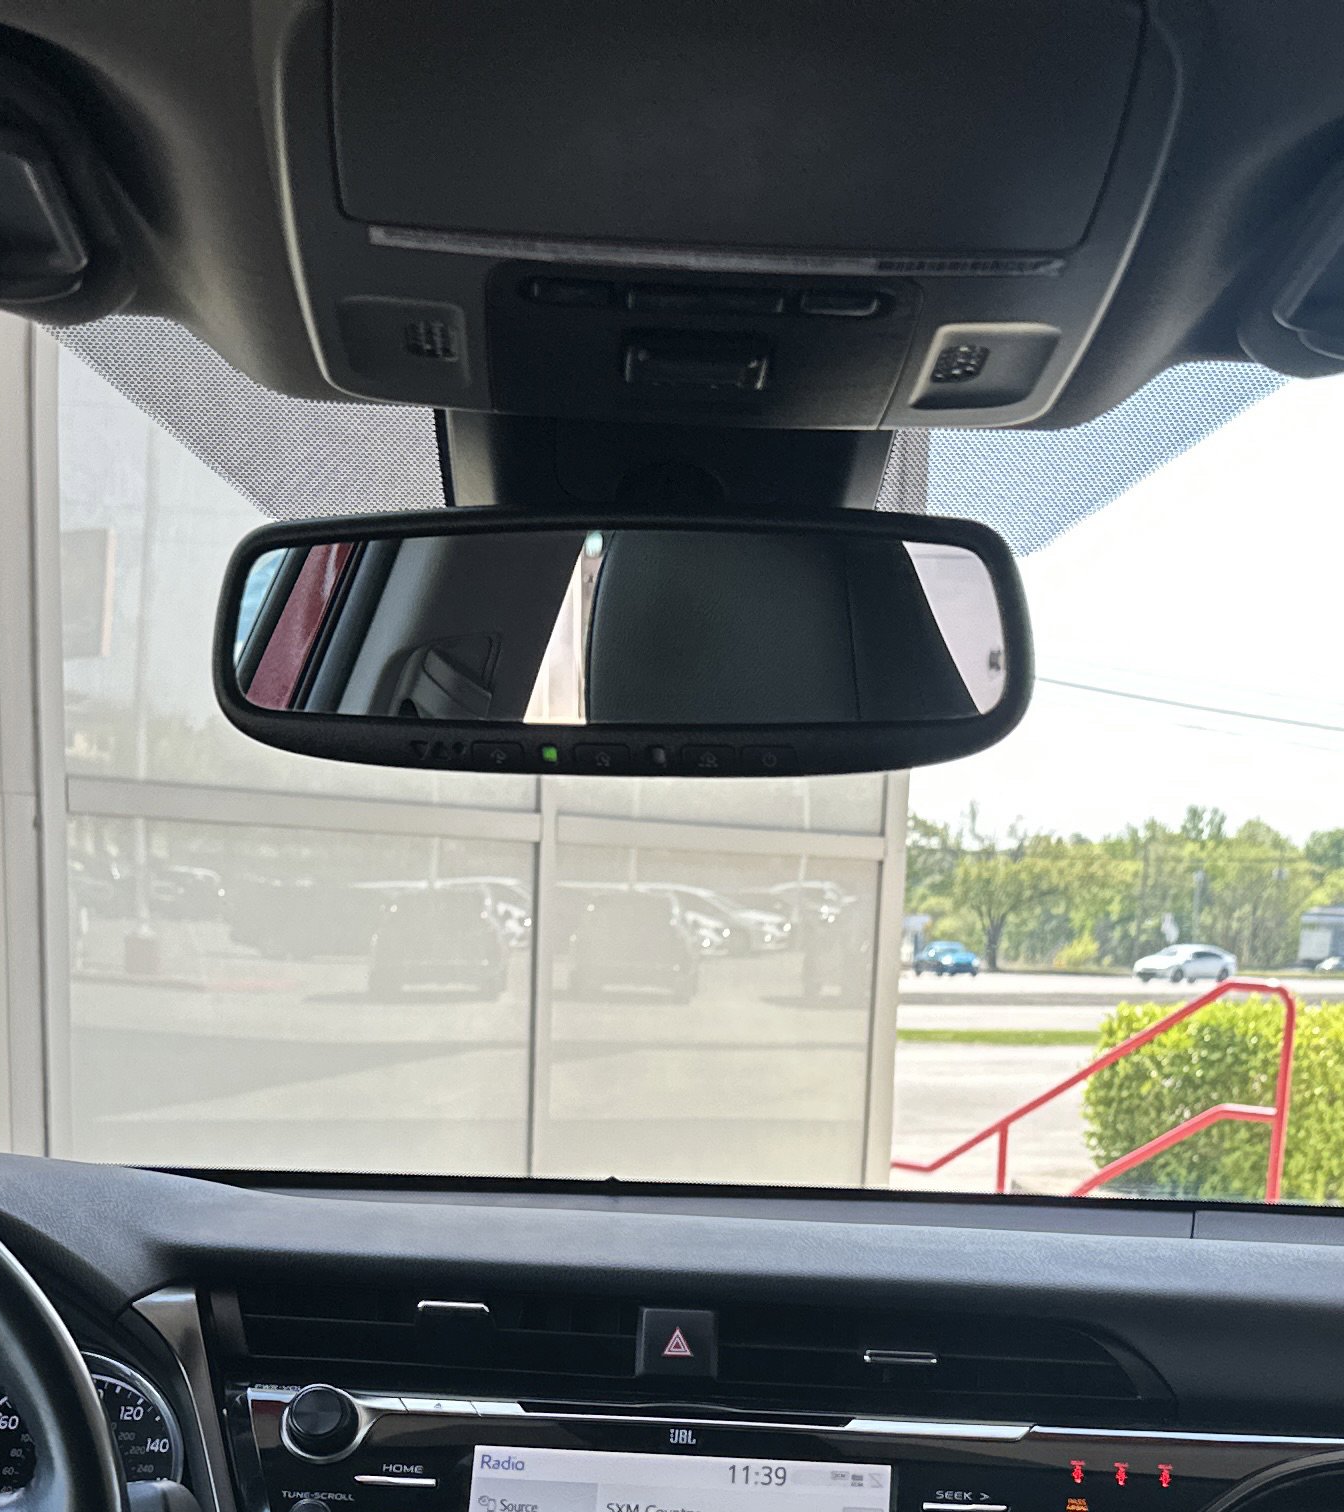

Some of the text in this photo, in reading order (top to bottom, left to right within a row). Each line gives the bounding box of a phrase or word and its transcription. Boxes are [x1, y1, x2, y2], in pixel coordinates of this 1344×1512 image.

[119, 1406, 144, 1422] 120
[669, 1428, 697, 1446] JBL
[145, 1438, 169, 1453] 140
[382, 1463, 425, 1474] HOME
[480, 1454, 525, 1471] Radio
[728, 1464, 788, 1486] 11:39
[935, 1490, 973, 1501] SEEK
